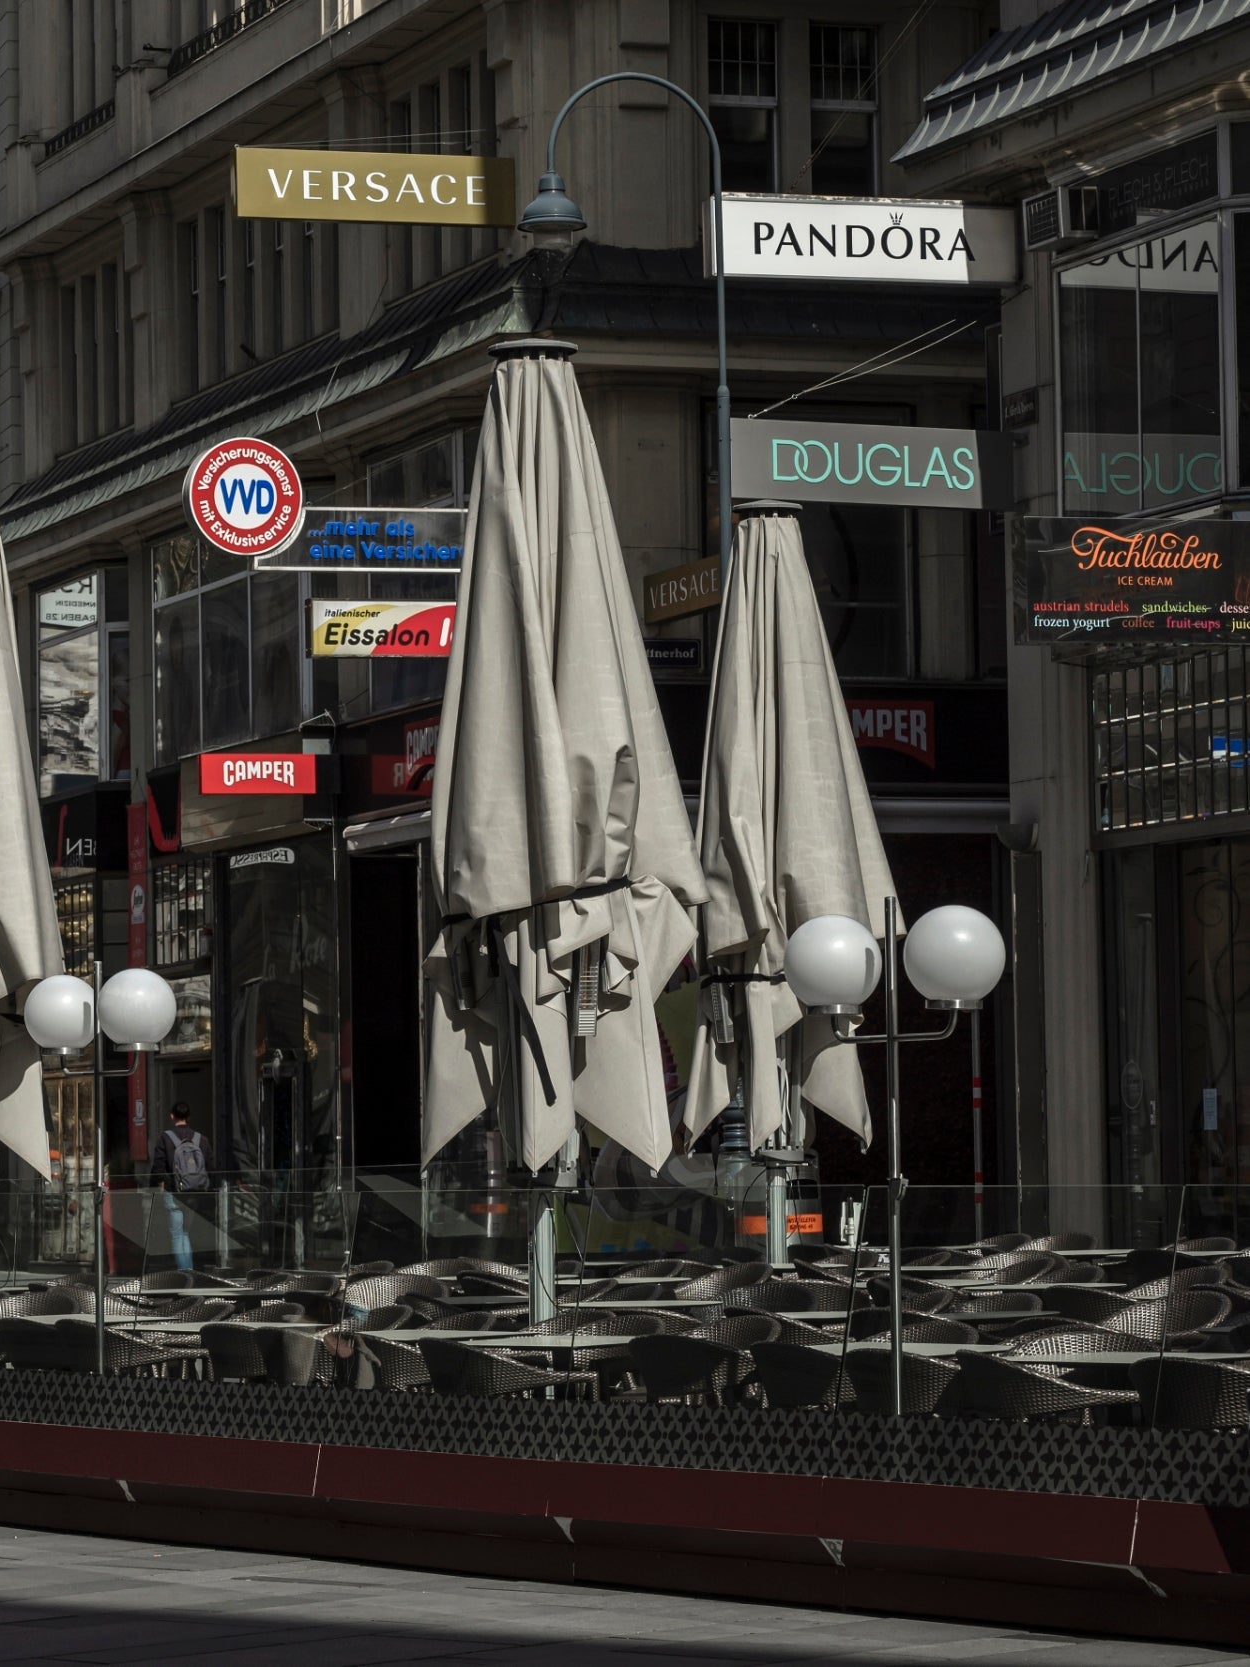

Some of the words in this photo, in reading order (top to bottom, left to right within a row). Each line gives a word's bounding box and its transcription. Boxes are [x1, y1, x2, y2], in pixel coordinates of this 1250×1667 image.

[267, 168, 486, 207] VERSACE
[196, 447, 295, 498] Versicherungsdienst
[771, 438, 975, 491] DOUGLAS
[218, 477, 275, 516] VVD
[199, 499, 215, 524] mit
[210, 504, 292, 547] Exklusivservice
[385, 519, 416, 537] als
[309, 542, 355, 560] eine
[1070, 525, 1223, 571] Tuchlauben
[649, 567, 719, 610] VERSACE
[1117, 576, 1134, 586] ICE
[1137, 576, 1173, 586] CREAM
[324, 607, 381, 619] italienischer
[1033, 602, 1081, 612] austrian
[1084, 600, 1130, 612] strudels
[1142, 600, 1207, 613] sandwiches
[324, 623, 430, 646] Eissalon
[1033, 614, 1070, 628] frozen
[1073, 617, 1111, 631] yogurt
[1122, 616, 1155, 628] coffee
[1166, 616, 1191, 628] fruit
[1194, 619, 1221, 632] cups
[222, 759, 295, 787] CAMPER
